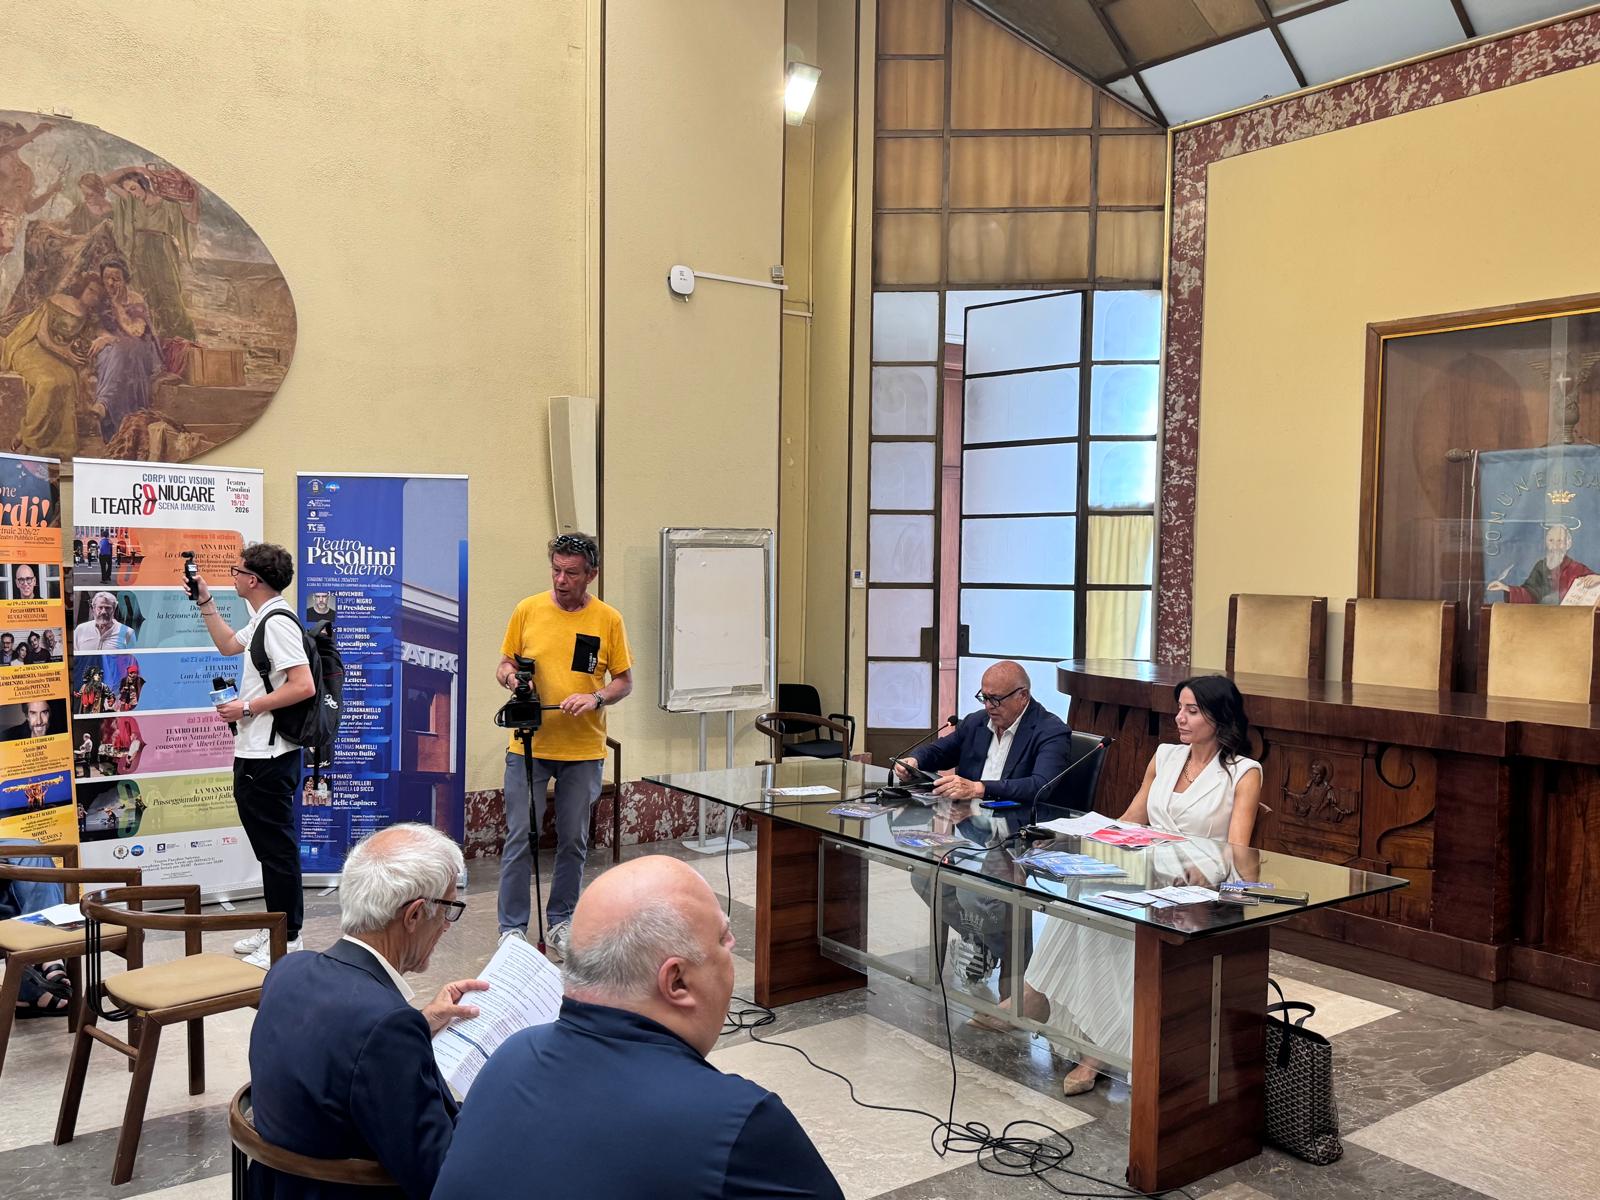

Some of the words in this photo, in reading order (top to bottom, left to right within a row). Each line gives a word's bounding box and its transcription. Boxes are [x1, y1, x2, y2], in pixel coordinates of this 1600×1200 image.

[142, 474, 166, 482] CORPI
[169, 475, 186, 484] VOCI
[189, 476, 215, 485] VISIONI
[92, 497, 101, 514] IL
[158, 502, 179, 510] SCENA
[181, 502, 216, 512] IMMERSIVA
[313, 536, 361, 551] Teatro
[307, 545, 396, 566] Pasolini
[334, 560, 394, 576] Salerno
[166, 726, 191, 734] TEATRO
